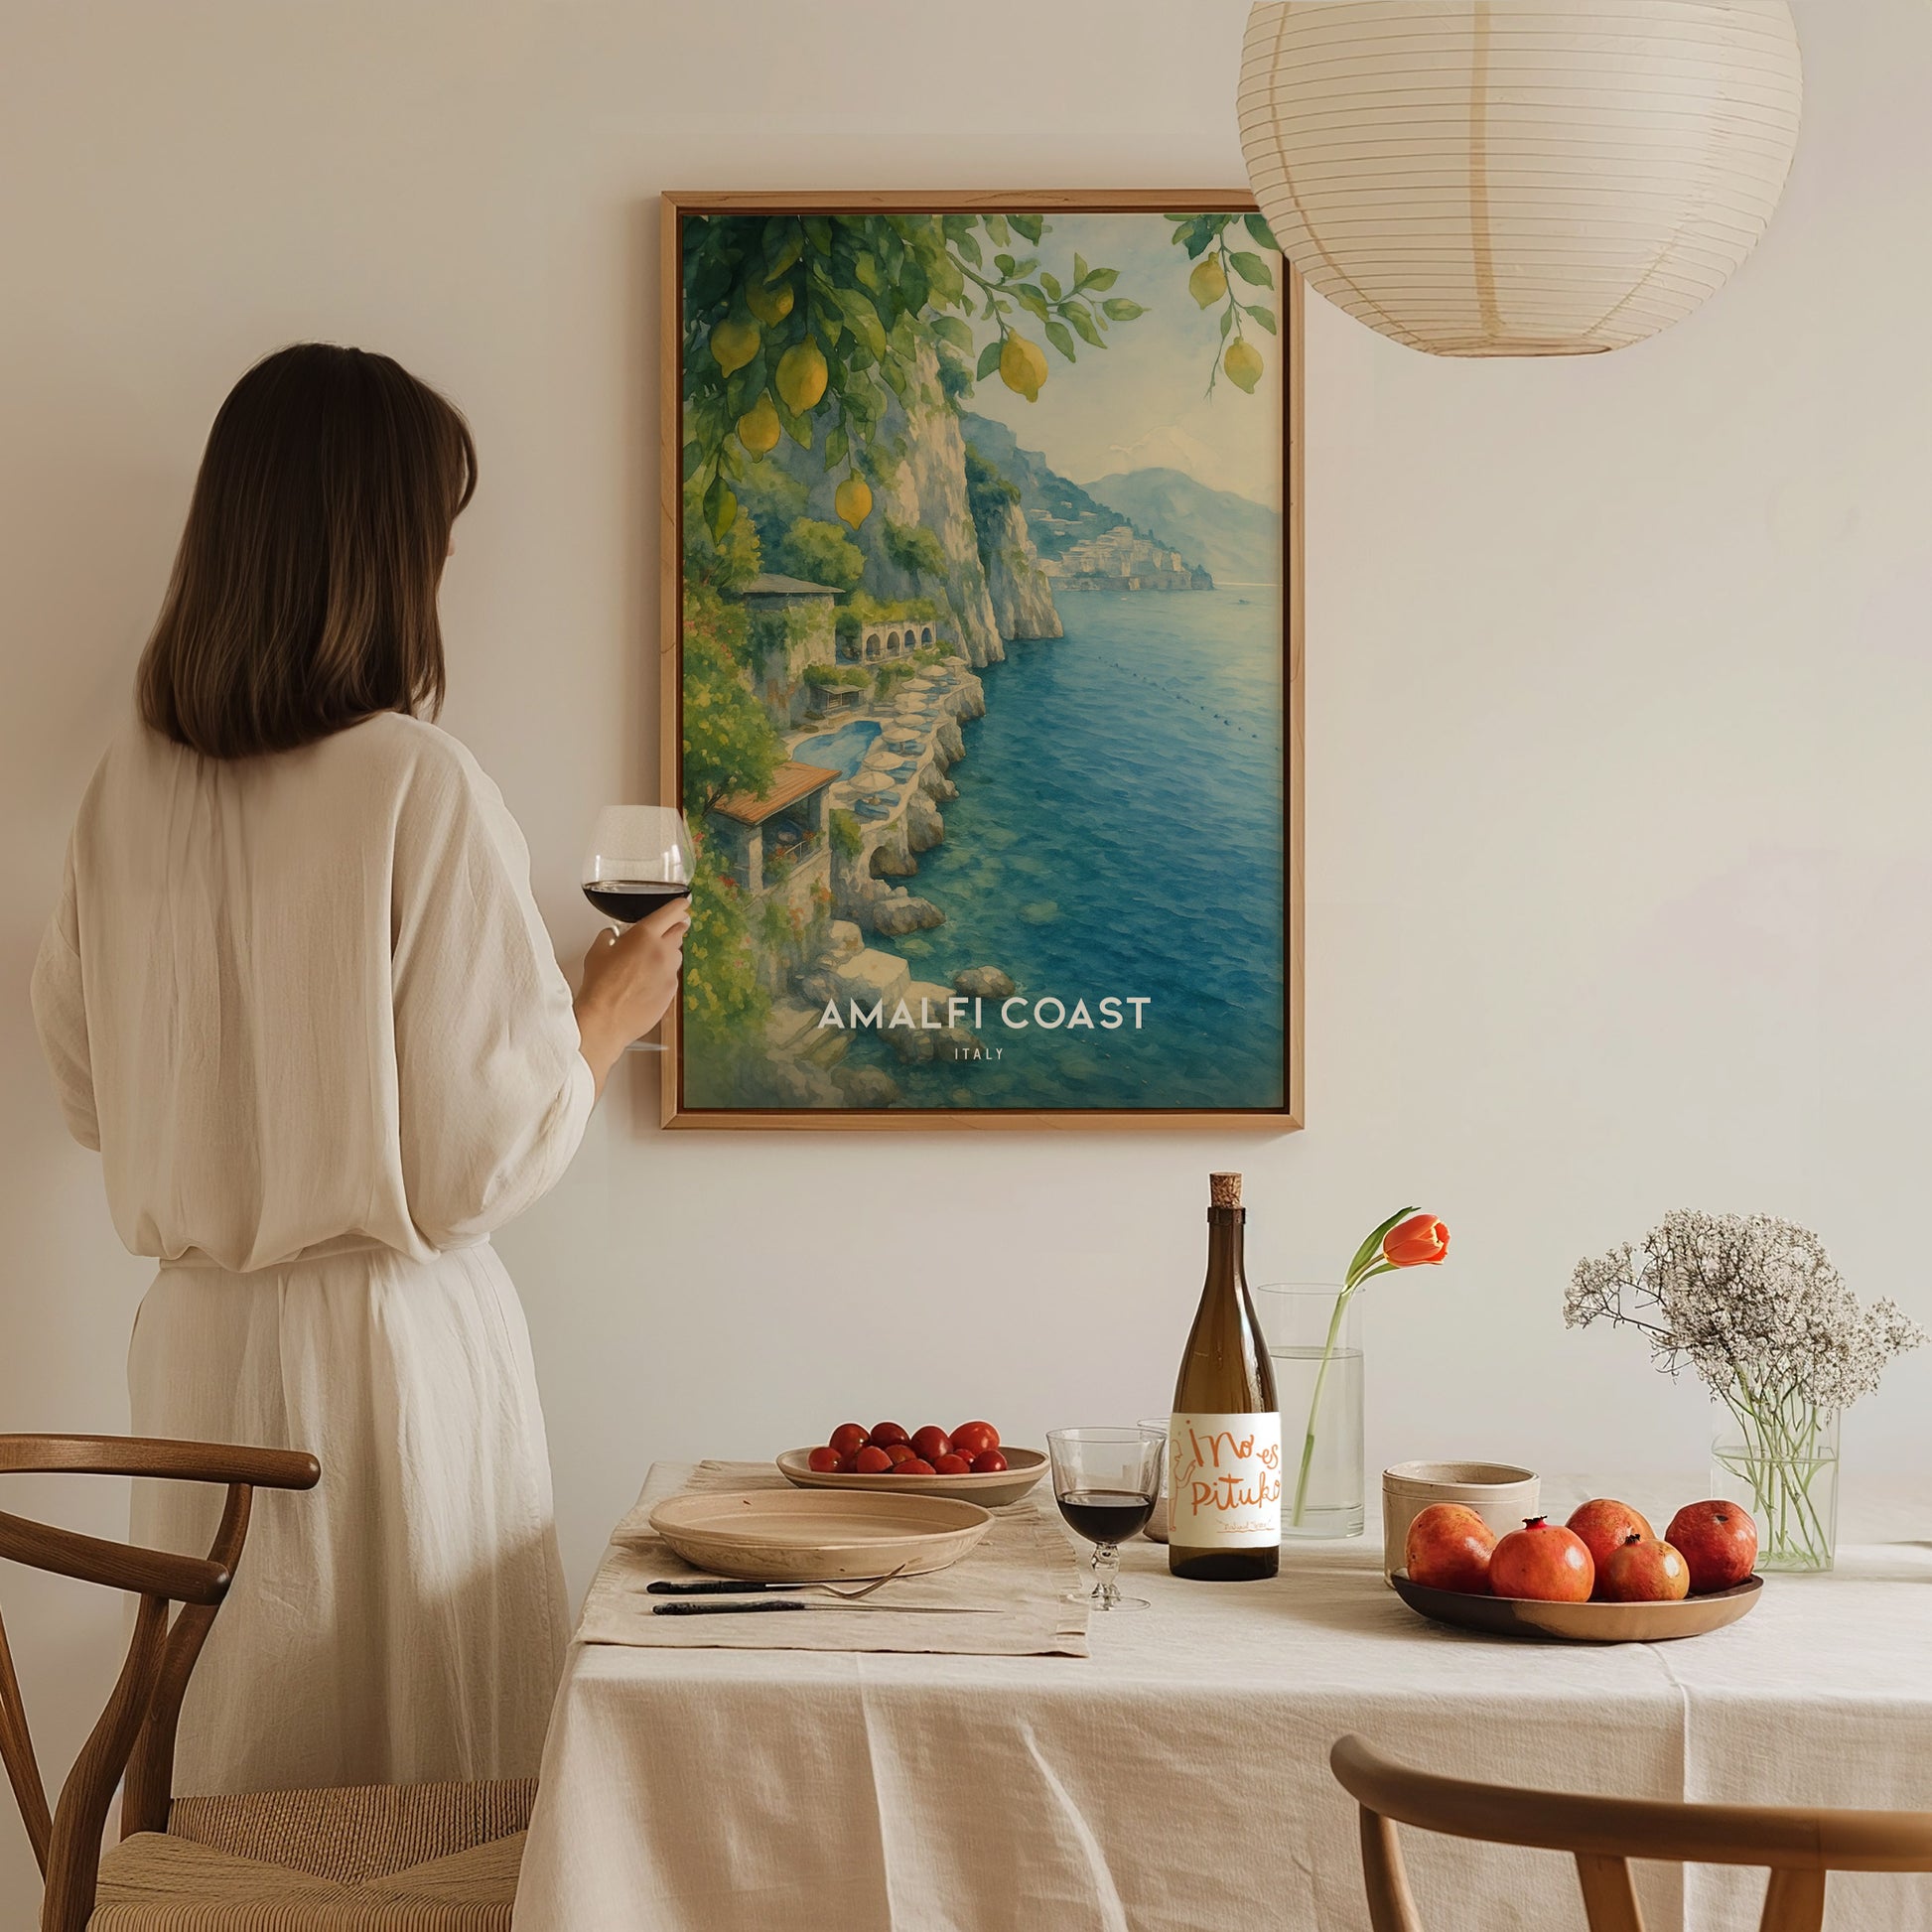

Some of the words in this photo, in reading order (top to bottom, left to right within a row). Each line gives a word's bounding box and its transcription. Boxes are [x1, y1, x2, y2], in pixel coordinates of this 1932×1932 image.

[818, 997, 982, 1029] AMALFI
[1001, 997, 1151, 1029] COAST
[954, 1047, 1003, 1060] ITALY
[1256, 1445, 1279, 1469] es
